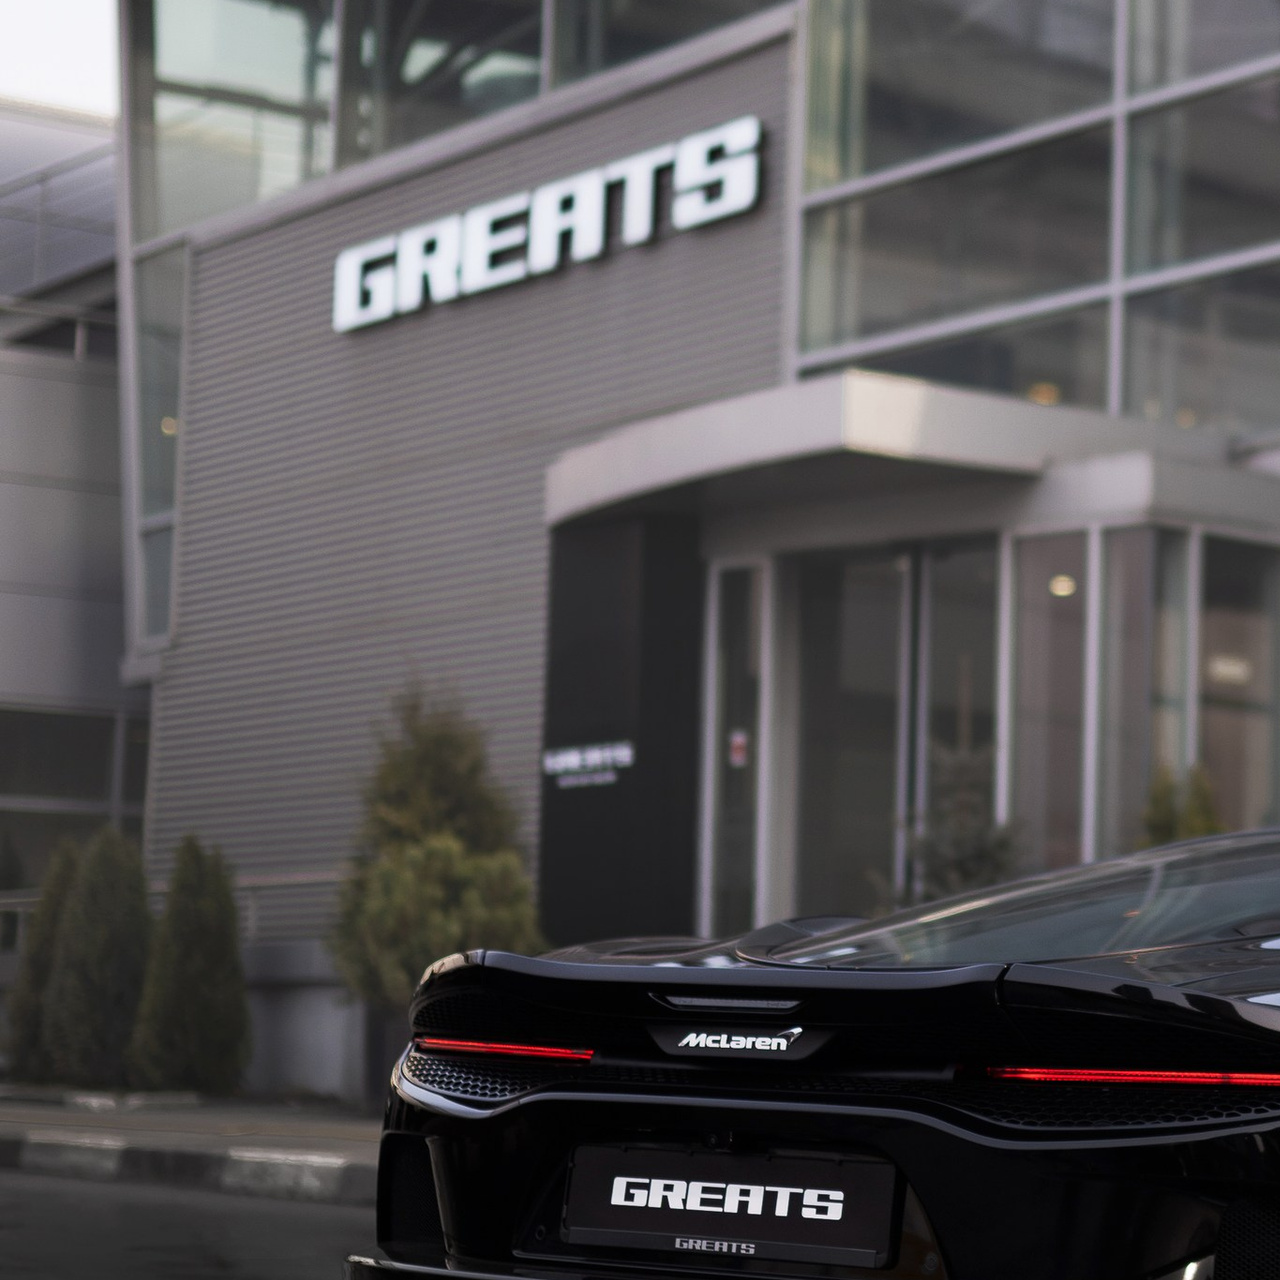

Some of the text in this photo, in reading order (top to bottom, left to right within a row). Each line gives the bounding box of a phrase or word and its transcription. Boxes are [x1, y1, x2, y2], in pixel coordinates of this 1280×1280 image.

[333, 115, 761, 333] GREATS
[678, 1032, 788, 1051] McLaren
[611, 1177, 844, 1220] GREATS
[675, 1237, 755, 1254] GREATS
